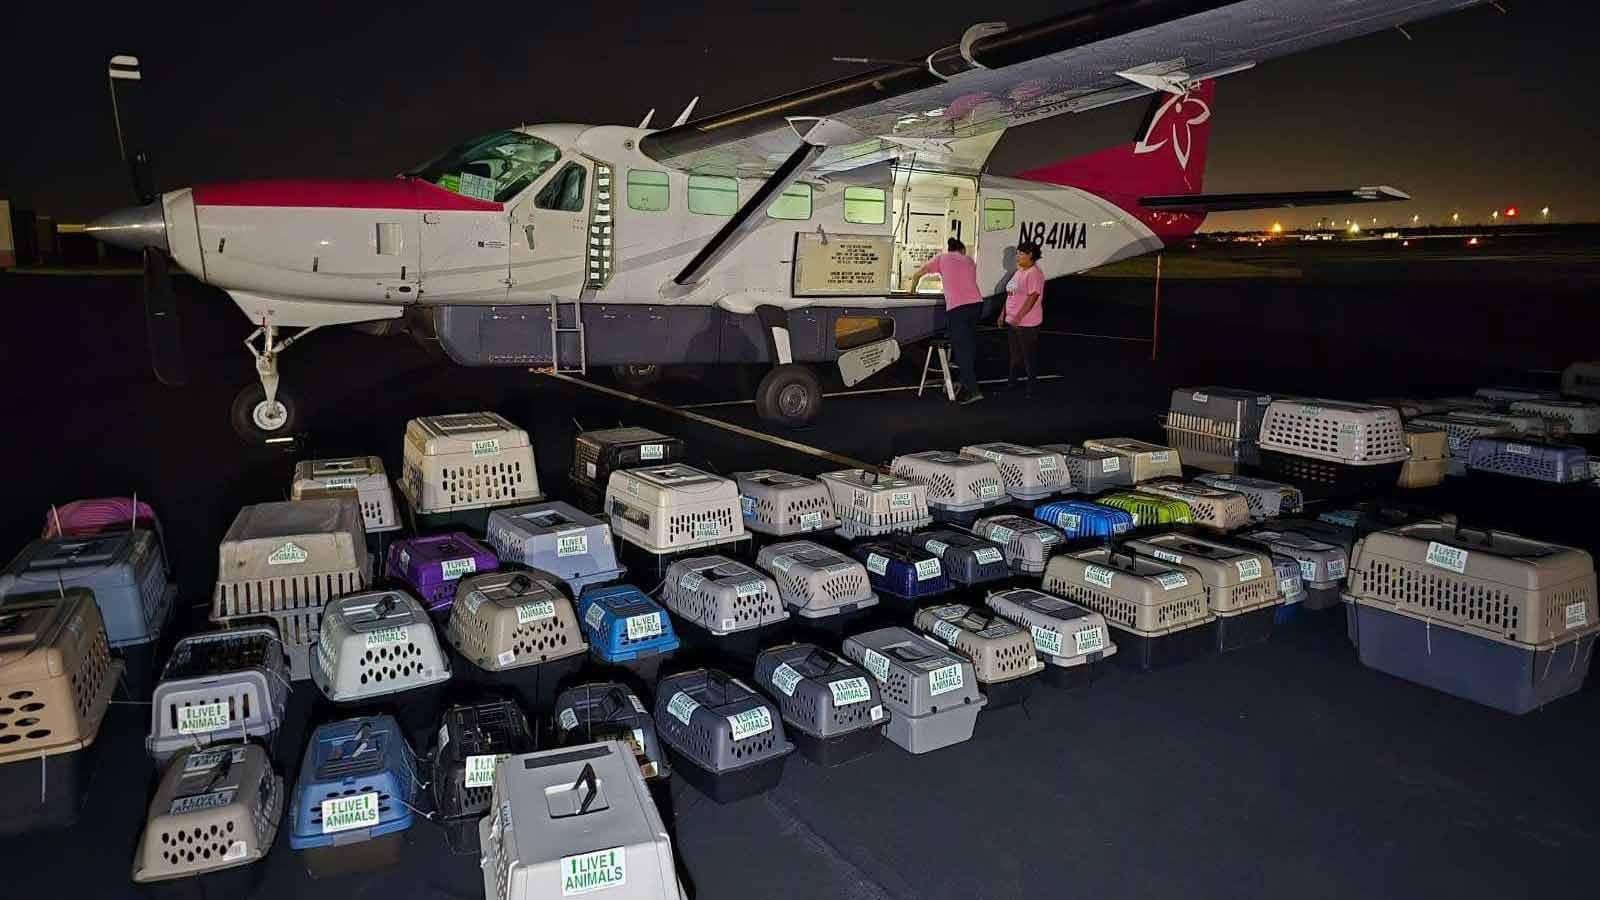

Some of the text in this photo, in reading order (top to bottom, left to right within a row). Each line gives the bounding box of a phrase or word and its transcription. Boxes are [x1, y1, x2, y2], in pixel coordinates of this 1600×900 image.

[1019, 221, 1087, 249] N841MA
[1428, 552, 1464, 569] ANIMALS
[520, 605, 553, 619] ANIMALS
[630, 623, 660, 635] ANIMALS
[368, 631, 408, 645] ANIMALS
[939, 667, 954, 679] LIVE
[841, 680, 859, 690] LIVE
[932, 675, 962, 691] ANIMALS
[836, 688, 869, 701] ANIMALS
[192, 707, 215, 718] LIVE
[742, 711, 759, 723] LIVE
[181, 715, 226, 730] ANIMALS
[735, 717, 769, 735] ANIMALS
[338, 798, 363, 813] LIVE
[326, 808, 376, 827] ANIMALS
[580, 855, 608, 873] LIVE
[565, 866, 623, 890] ANIMALS
